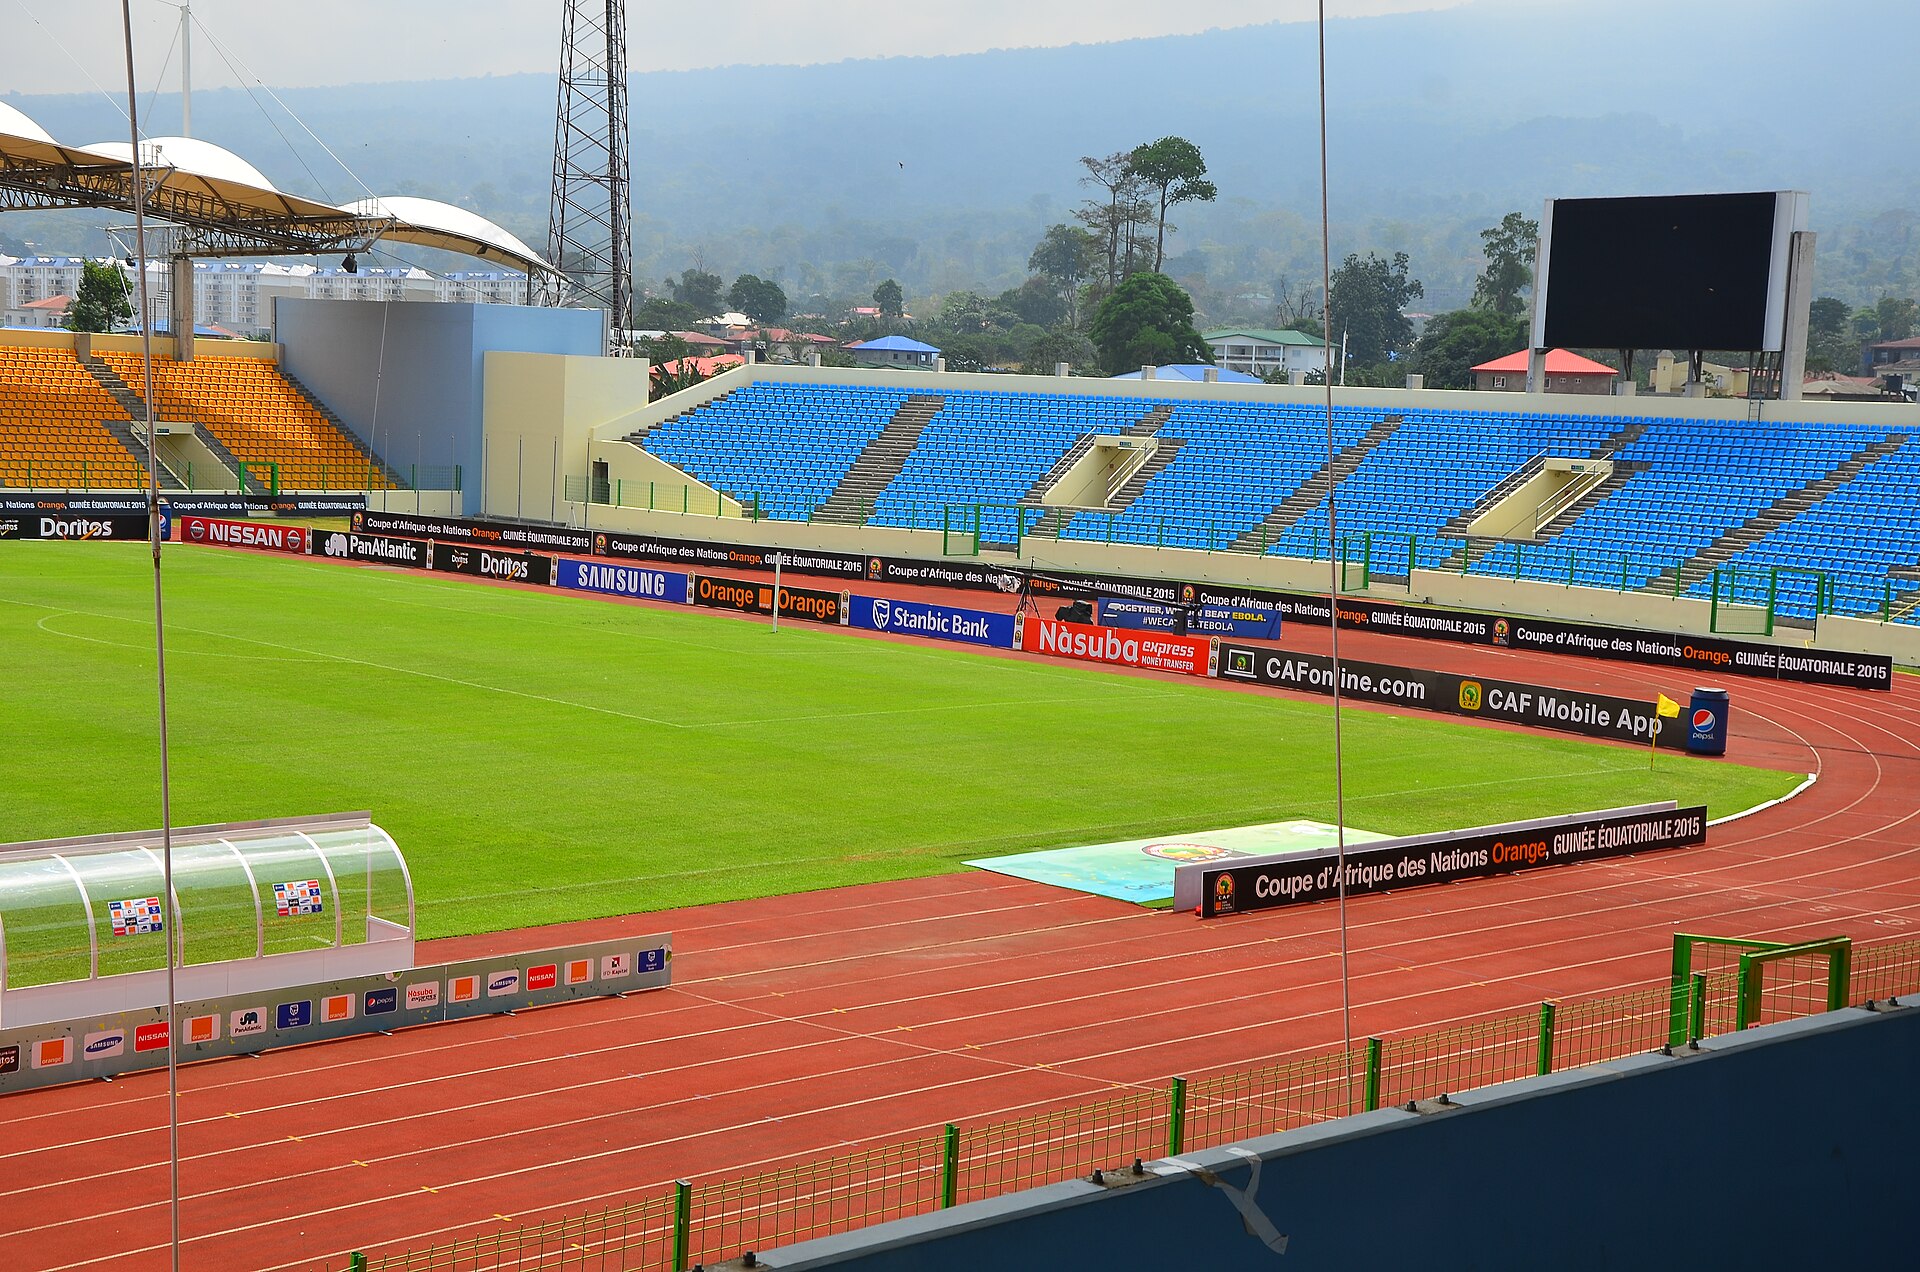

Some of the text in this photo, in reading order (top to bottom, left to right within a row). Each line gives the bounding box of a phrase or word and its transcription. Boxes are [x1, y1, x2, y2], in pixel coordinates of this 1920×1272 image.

[6, 501, 35, 509] Nations
[37, 502, 67, 510] Orange,
[69, 500, 91, 509] GUINÉE
[92, 500, 131, 510] ÉQUATORIALE
[131, 501, 146, 509] 2015
[173, 502, 196, 510] Coupe
[197, 502, 228, 510] d'Afrique
[298, 500, 317, 510] GUINÉE
[352, 502, 365, 510] 2015
[40, 518, 112, 536] Doritos
[209, 523, 282, 547] NISSAN
[367, 518, 590, 547] Coupe d'Afrique des Nations Orange, GUINÉE ÉQUATORIALE 2015
[350, 535, 417, 560] PanAtlantic
[611, 540, 862, 572] Coupe d'Afrique des Nations Orange, GUIÉE ÉQUATORIALE 2015
[481, 553, 528, 578] Doritos
[578, 564, 665, 596] SAMSUNG
[888, 564, 919, 578] Coupe
[920, 567, 963, 582] d'Afrique
[965, 572, 983, 583] des
[1030, 579, 1060, 592] range,
[1154, 587, 1175, 600] 2015
[700, 578, 754, 608] Orange
[778, 589, 836, 618] Orange
[894, 607, 989, 639] Stanbic Bank
[1118, 603, 1164, 616] OGETHER,
[1205, 609, 1231, 619] BEAT
[1232, 612, 1267, 623] EBOLA.
[1200, 592, 1230, 606] Coupe
[1231, 595, 1274, 611] d'Afrique
[1275, 601, 1292, 613] des
[1295, 603, 1331, 618] Nations
[1372, 611, 1402, 626] GUINÉE
[1403, 613, 1461, 633] ÉQUATORIALE
[1463, 621, 1486, 635] 2015
[1039, 621, 1139, 663] Nàsuba
[1142, 640, 1195, 658] express
[1516, 627, 1554, 644] Coupe
[1611, 638, 1633, 652] des
[1635, 640, 1682, 657] Nations
[1683, 645, 1732, 666] Orange,
[1735, 651, 1776, 668] GUINÉE
[1778, 654, 1855, 677] ÉQUATORIALE
[1857, 664, 1887, 680] 2015
[1142, 655, 1195, 671] MONEY TRANSFER
[1266, 657, 1425, 700] CAFonine.com
[1488, 688, 1663, 738] CAF Mobile App
[1693, 732, 1714, 740] pepsi
[1255, 873, 1313, 899] Coupe
[1397, 856, 1426, 879] des
[1430, 848, 1488, 874] Nations
[1492, 840, 1550, 865] Orange,
[1553, 826, 1596, 856] GUINÉE
[1598, 819, 1672, 849] ÉQUATORIALE
[1674, 816, 1700, 838] 2015
[529, 973, 554, 982] NISSAN
[376, 996, 394, 1006] pepsi
[138, 1032, 169, 1042] NISSAN
[42, 1055, 62, 1065] orange
